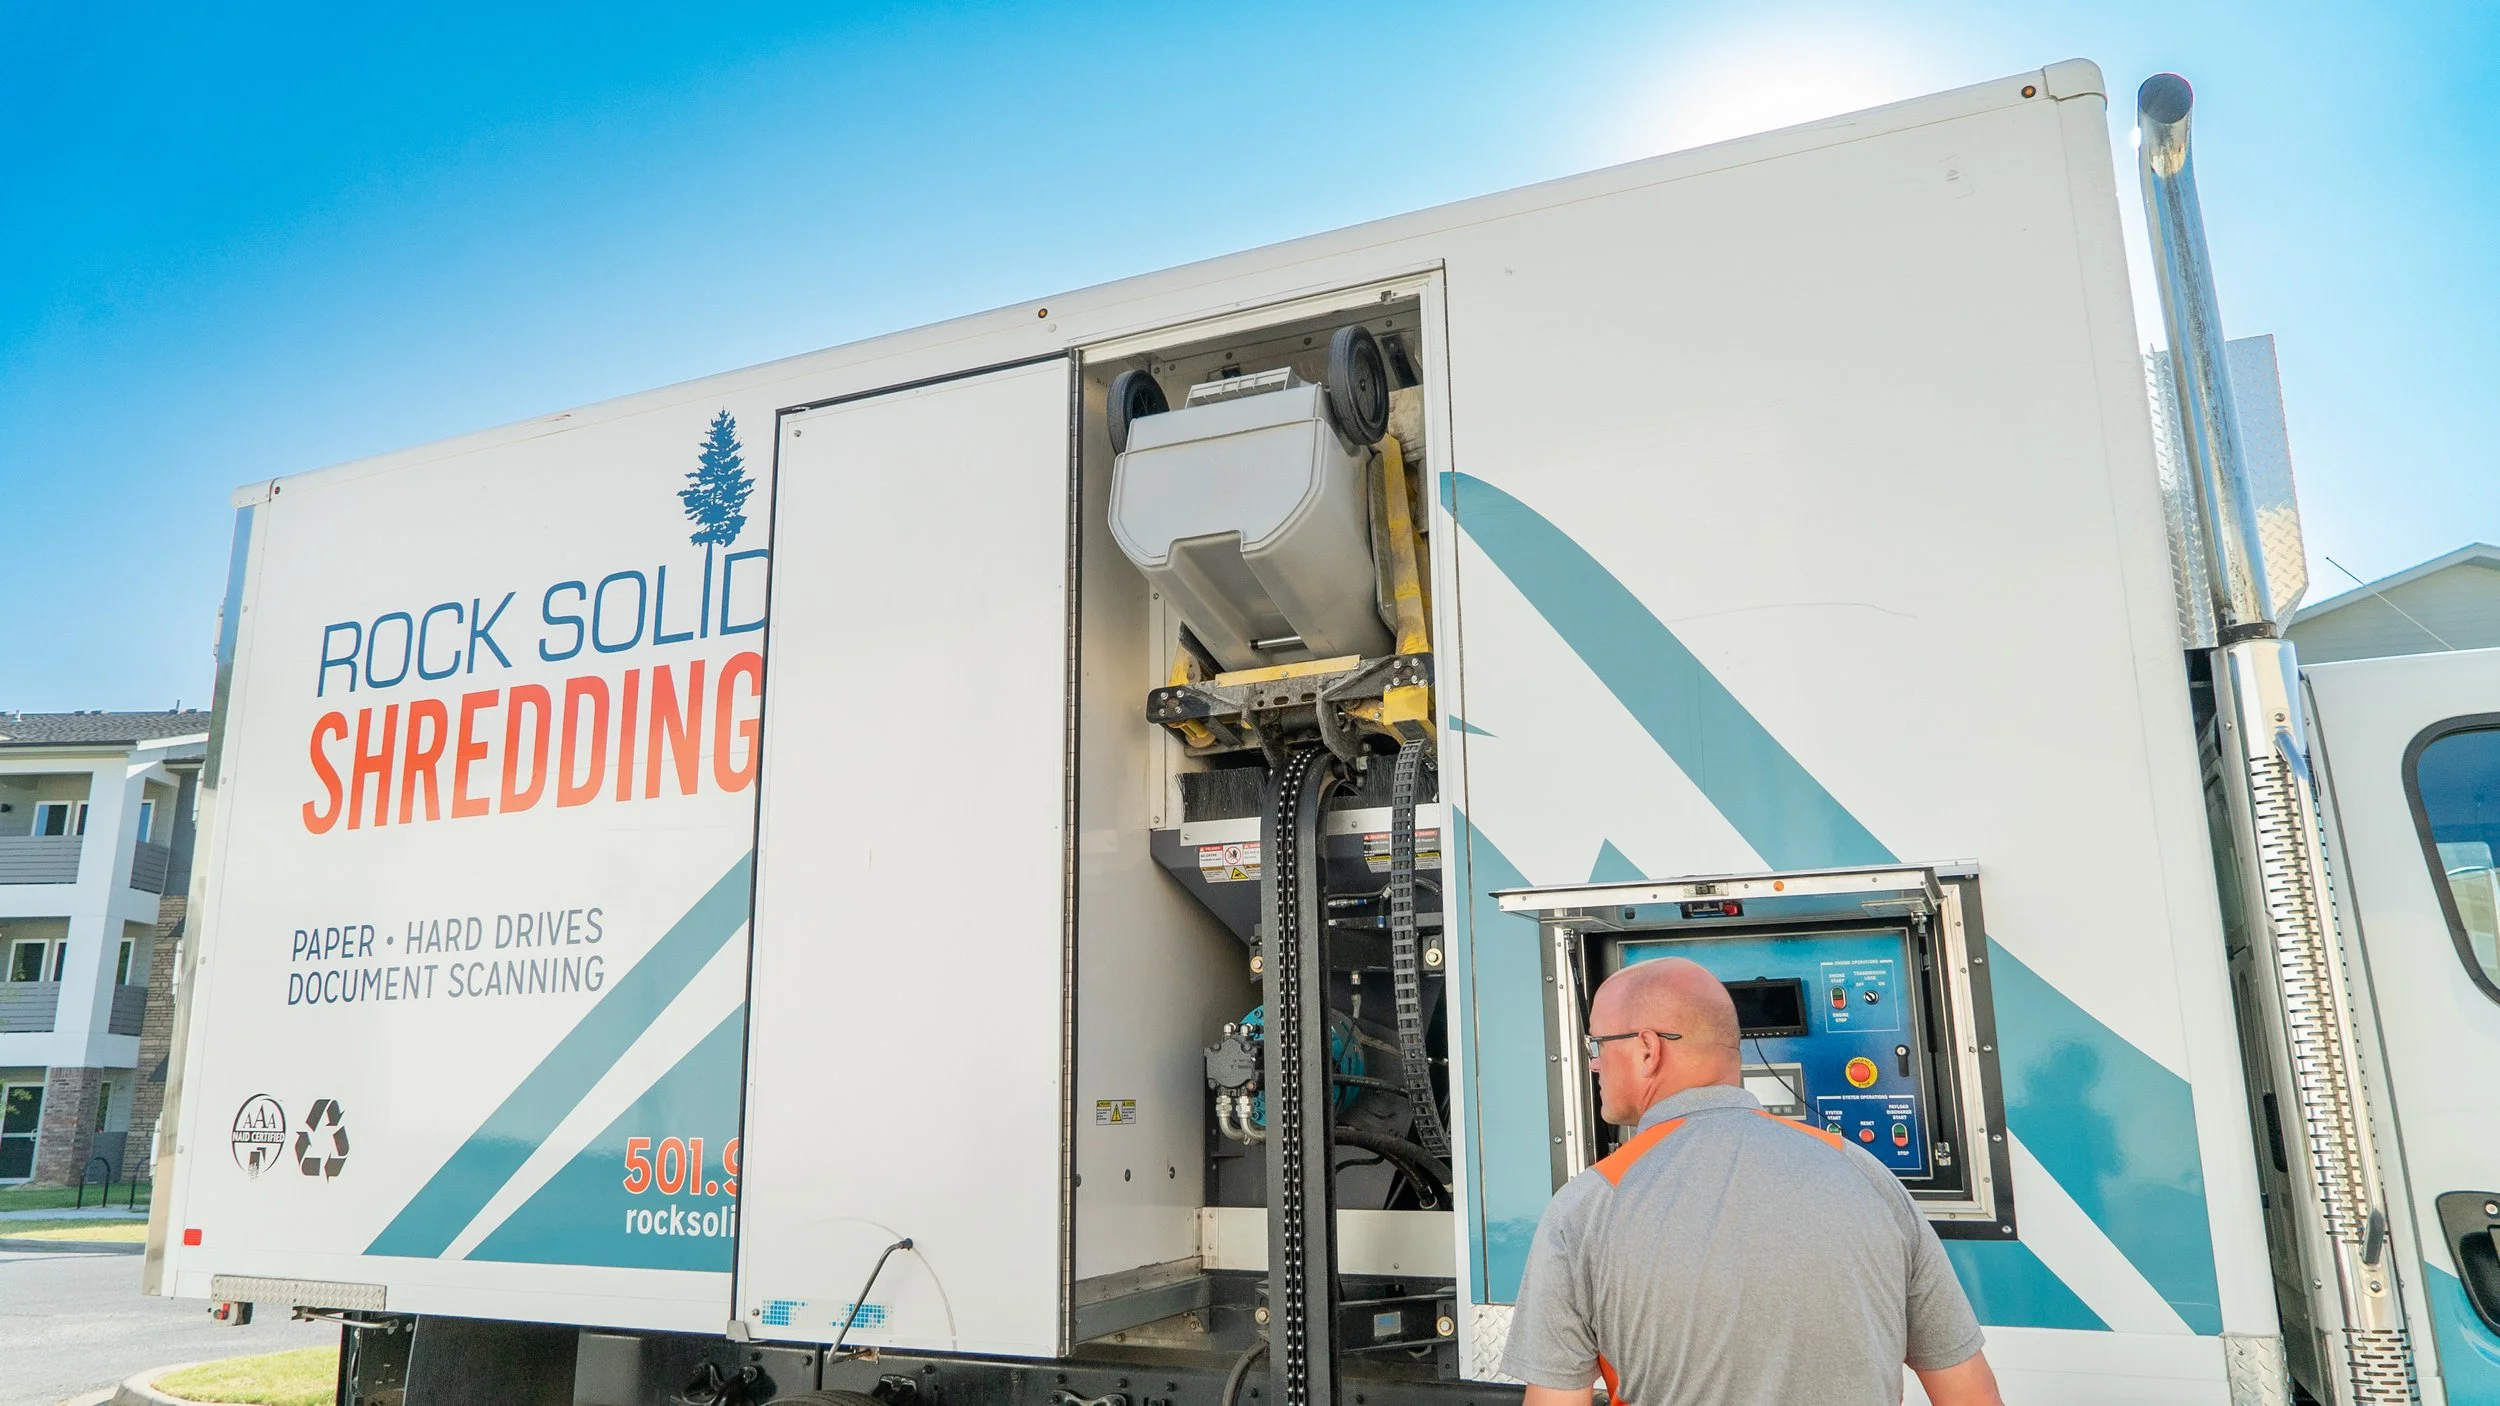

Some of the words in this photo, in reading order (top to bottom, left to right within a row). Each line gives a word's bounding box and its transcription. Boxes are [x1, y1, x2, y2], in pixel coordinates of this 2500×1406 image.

[316, 591, 516, 698] ROCK
[538, 547, 769, 663] SOLID
[302, 651, 763, 835] SHREDDING
[292, 924, 375, 962] PAPER
[406, 916, 483, 954] HARD
[495, 907, 604, 949] DRIVES
[287, 964, 439, 1006] DOCUMENT
[447, 955, 605, 998] SCANNING
[232, 1131, 250, 1142] NAID
[251, 1131, 285, 1142] CERTIFIED
[242, 1104, 277, 1129] AAA
[625, 1204, 736, 1237] rocksoli
